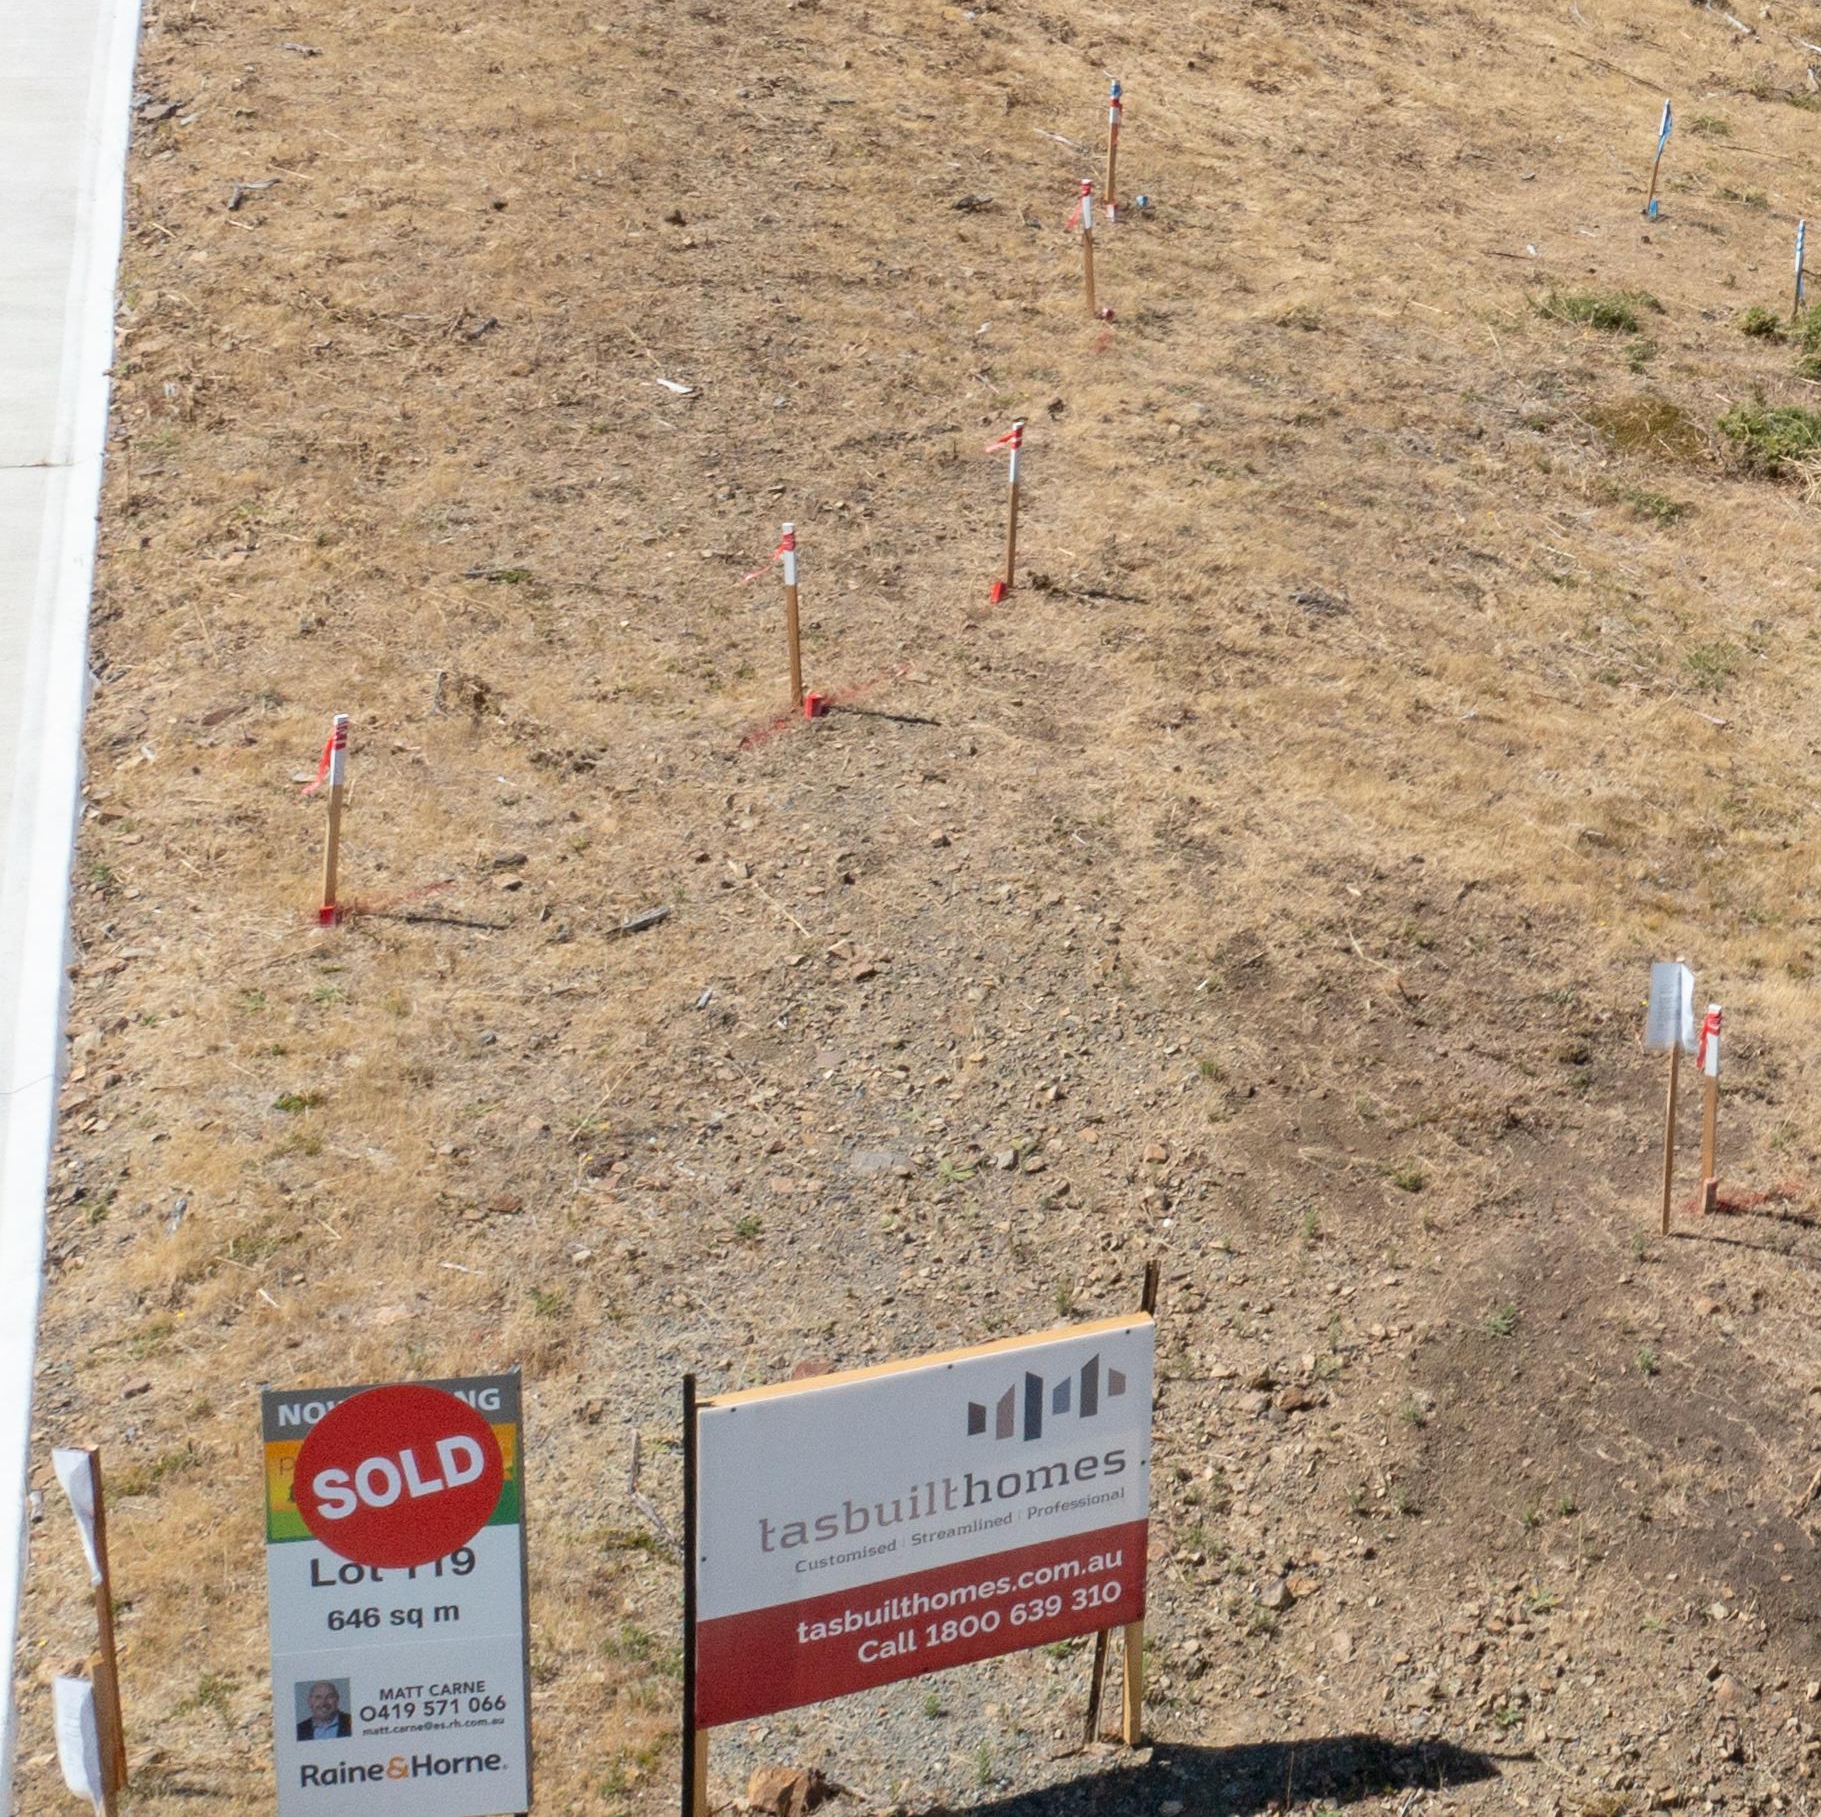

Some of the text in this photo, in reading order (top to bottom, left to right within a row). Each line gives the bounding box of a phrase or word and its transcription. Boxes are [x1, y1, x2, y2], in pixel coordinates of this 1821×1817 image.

[278, 1399, 344, 1427] NO
[312, 1435, 485, 1520] SOLD
[759, 1449, 1127, 1553] tasbuilthomes
[795, 1487, 1125, 1574] Customised Streamlined Professional
[327, 1604, 460, 1631] 646 sq m
[797, 1548, 1124, 1644] tasbuilthomes.com.au
[857, 1581, 1122, 1663] Call 1800 639 310
[379, 1680, 486, 1701] MATT CARNE
[423, 1698, 460, 1717] 571
[468, 1695, 506, 1713] 066
